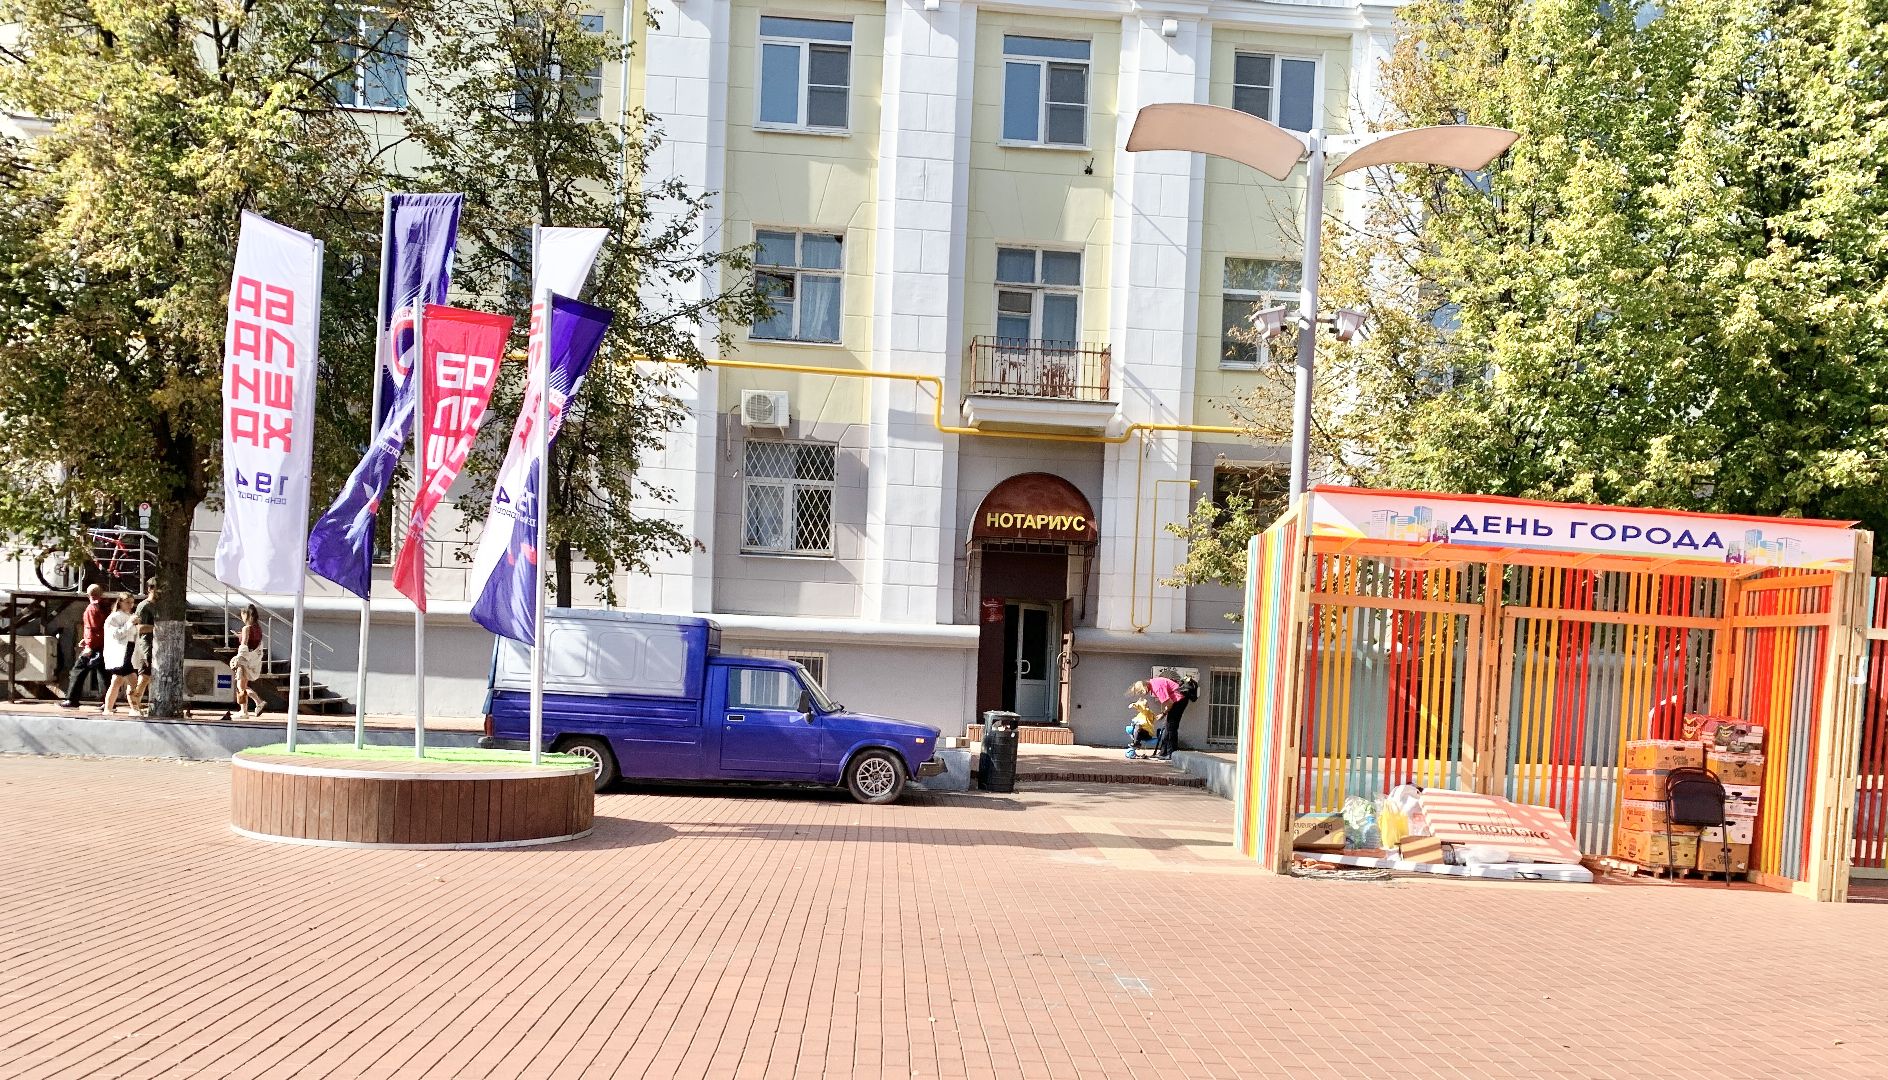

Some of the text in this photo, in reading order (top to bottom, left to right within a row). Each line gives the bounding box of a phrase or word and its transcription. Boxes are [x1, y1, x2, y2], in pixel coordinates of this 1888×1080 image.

[986, 512, 1086, 532] НОТАРИУС
[1450, 514, 1724, 550] ДЕНЬ ГОРОДА
[1457, 822, 1551, 840] ПЕНОПЛЭКС
